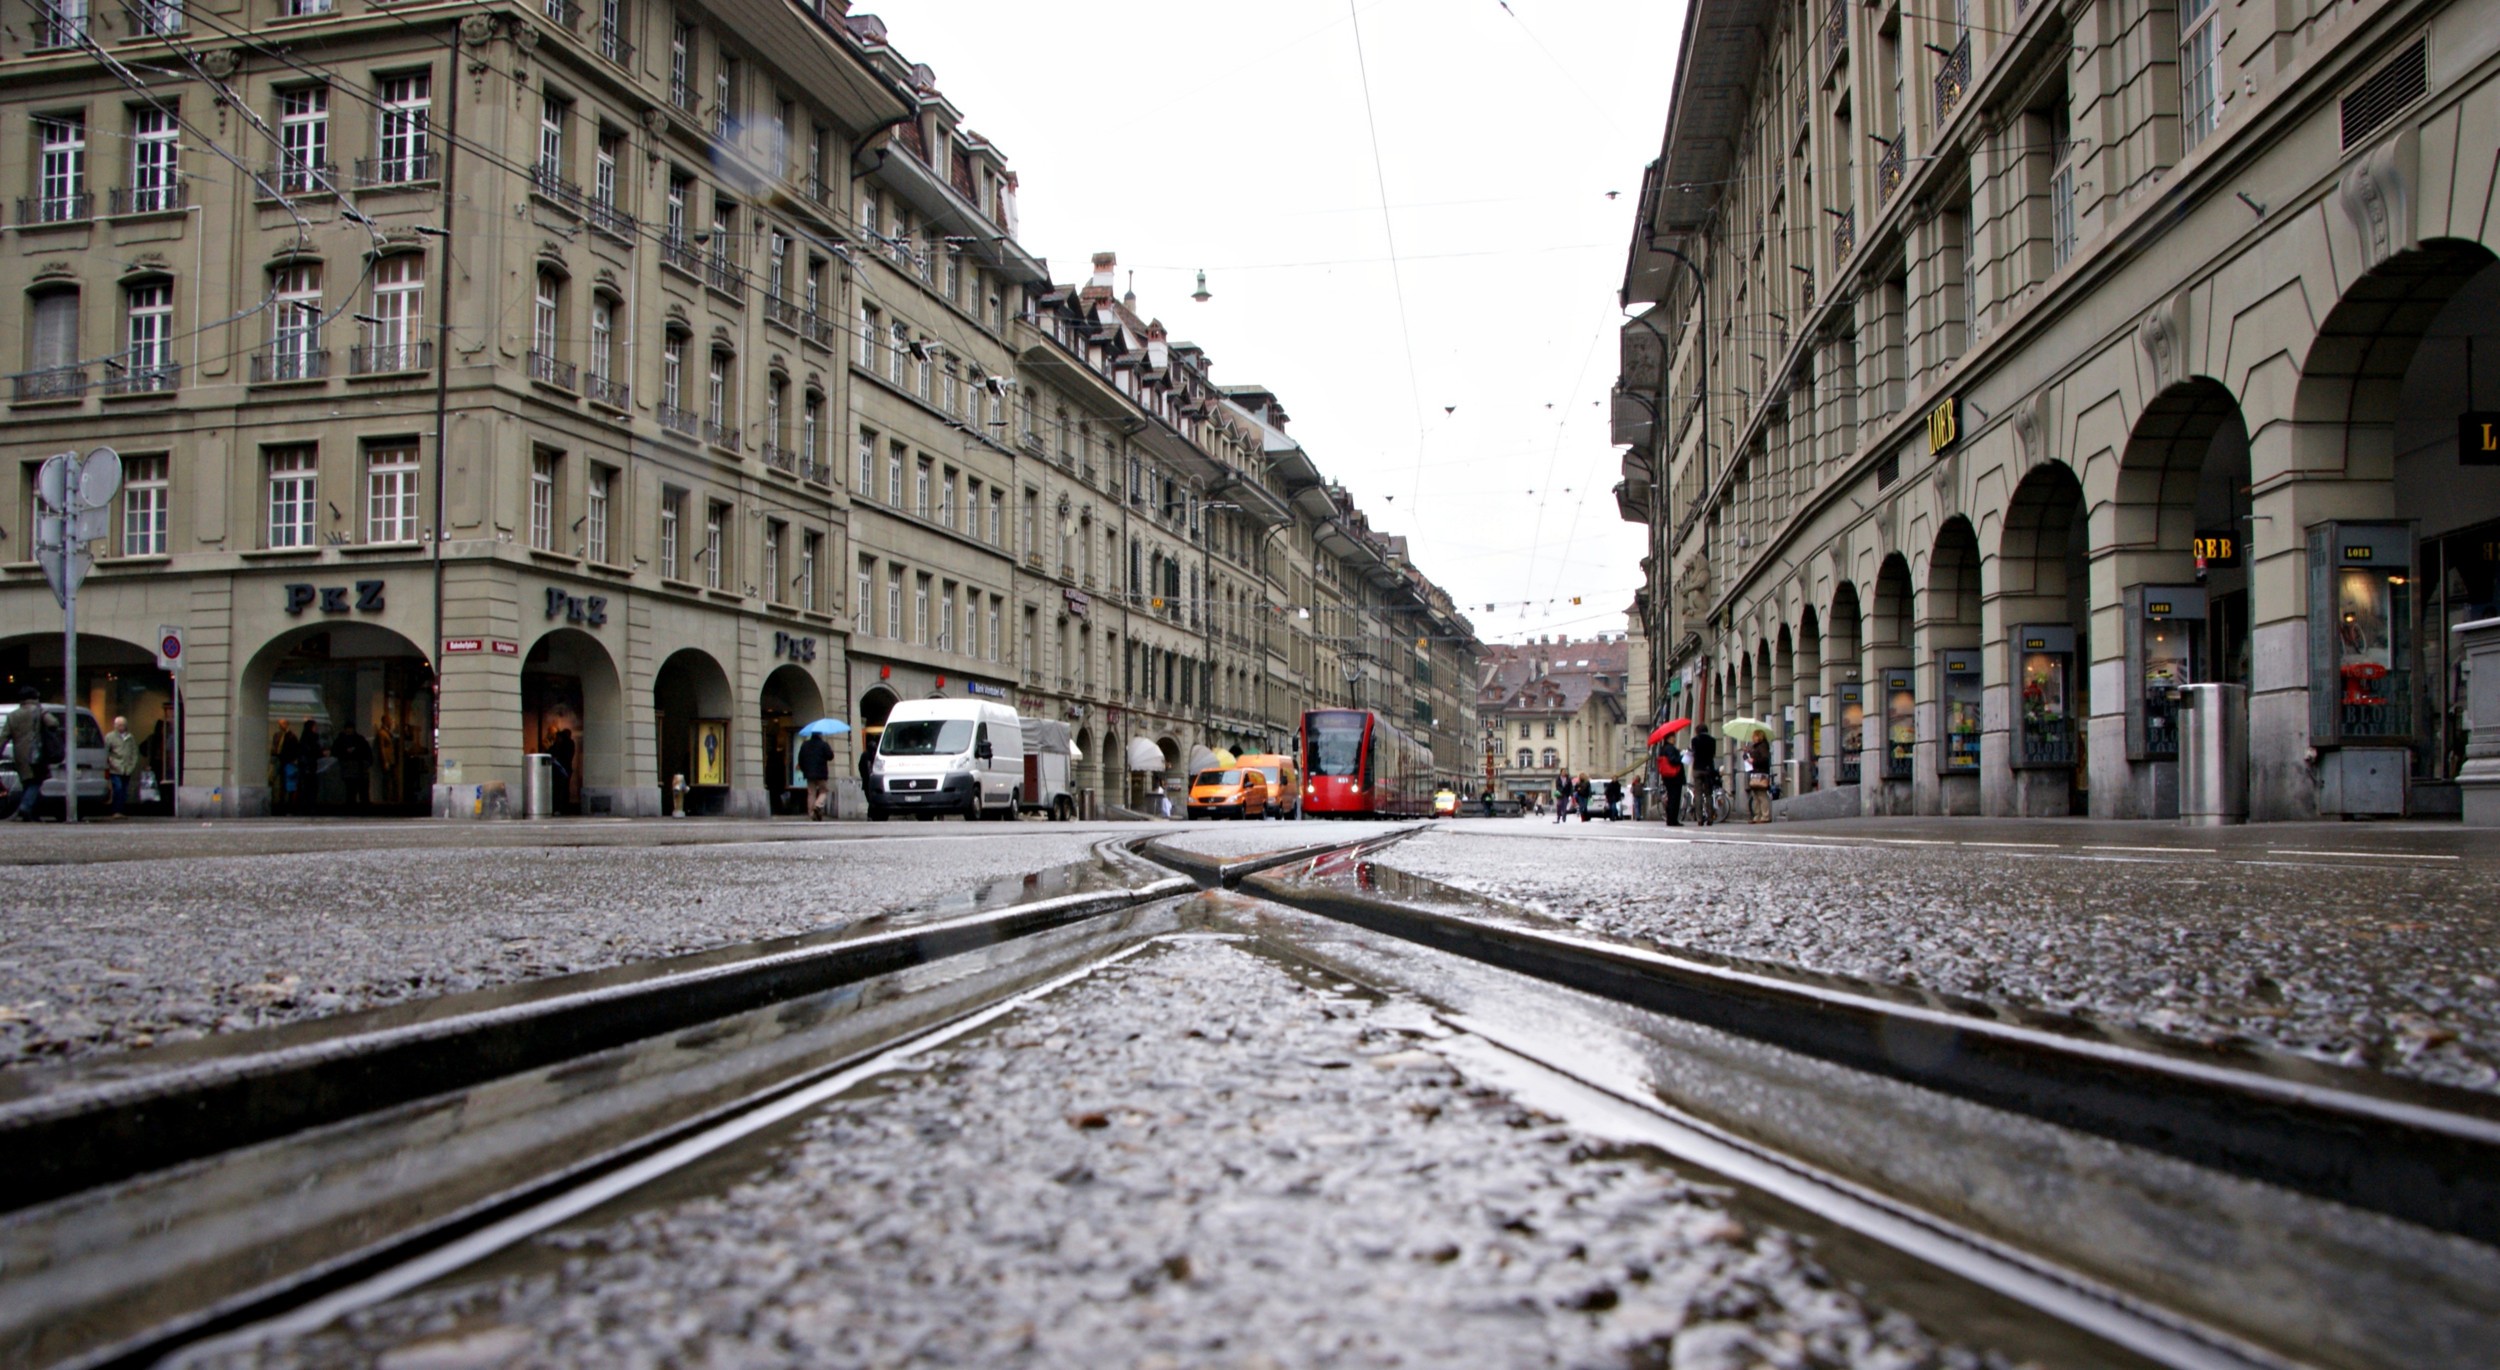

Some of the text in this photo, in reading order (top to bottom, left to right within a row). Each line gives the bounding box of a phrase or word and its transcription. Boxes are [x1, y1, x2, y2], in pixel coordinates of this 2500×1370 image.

[1926, 397, 1955, 456] LOEB
[2481, 423, 2497, 451] L
[2194, 538, 2232, 558] OEB
[2347, 547, 2370, 558] LOEB
[284, 580, 385, 615] PKZ
[546, 587, 608, 626] PKZ
[2151, 604, 2170, 612] LOEB
[775, 631, 817, 662] PKZ
[2028, 640, 2044, 648] LOEB
